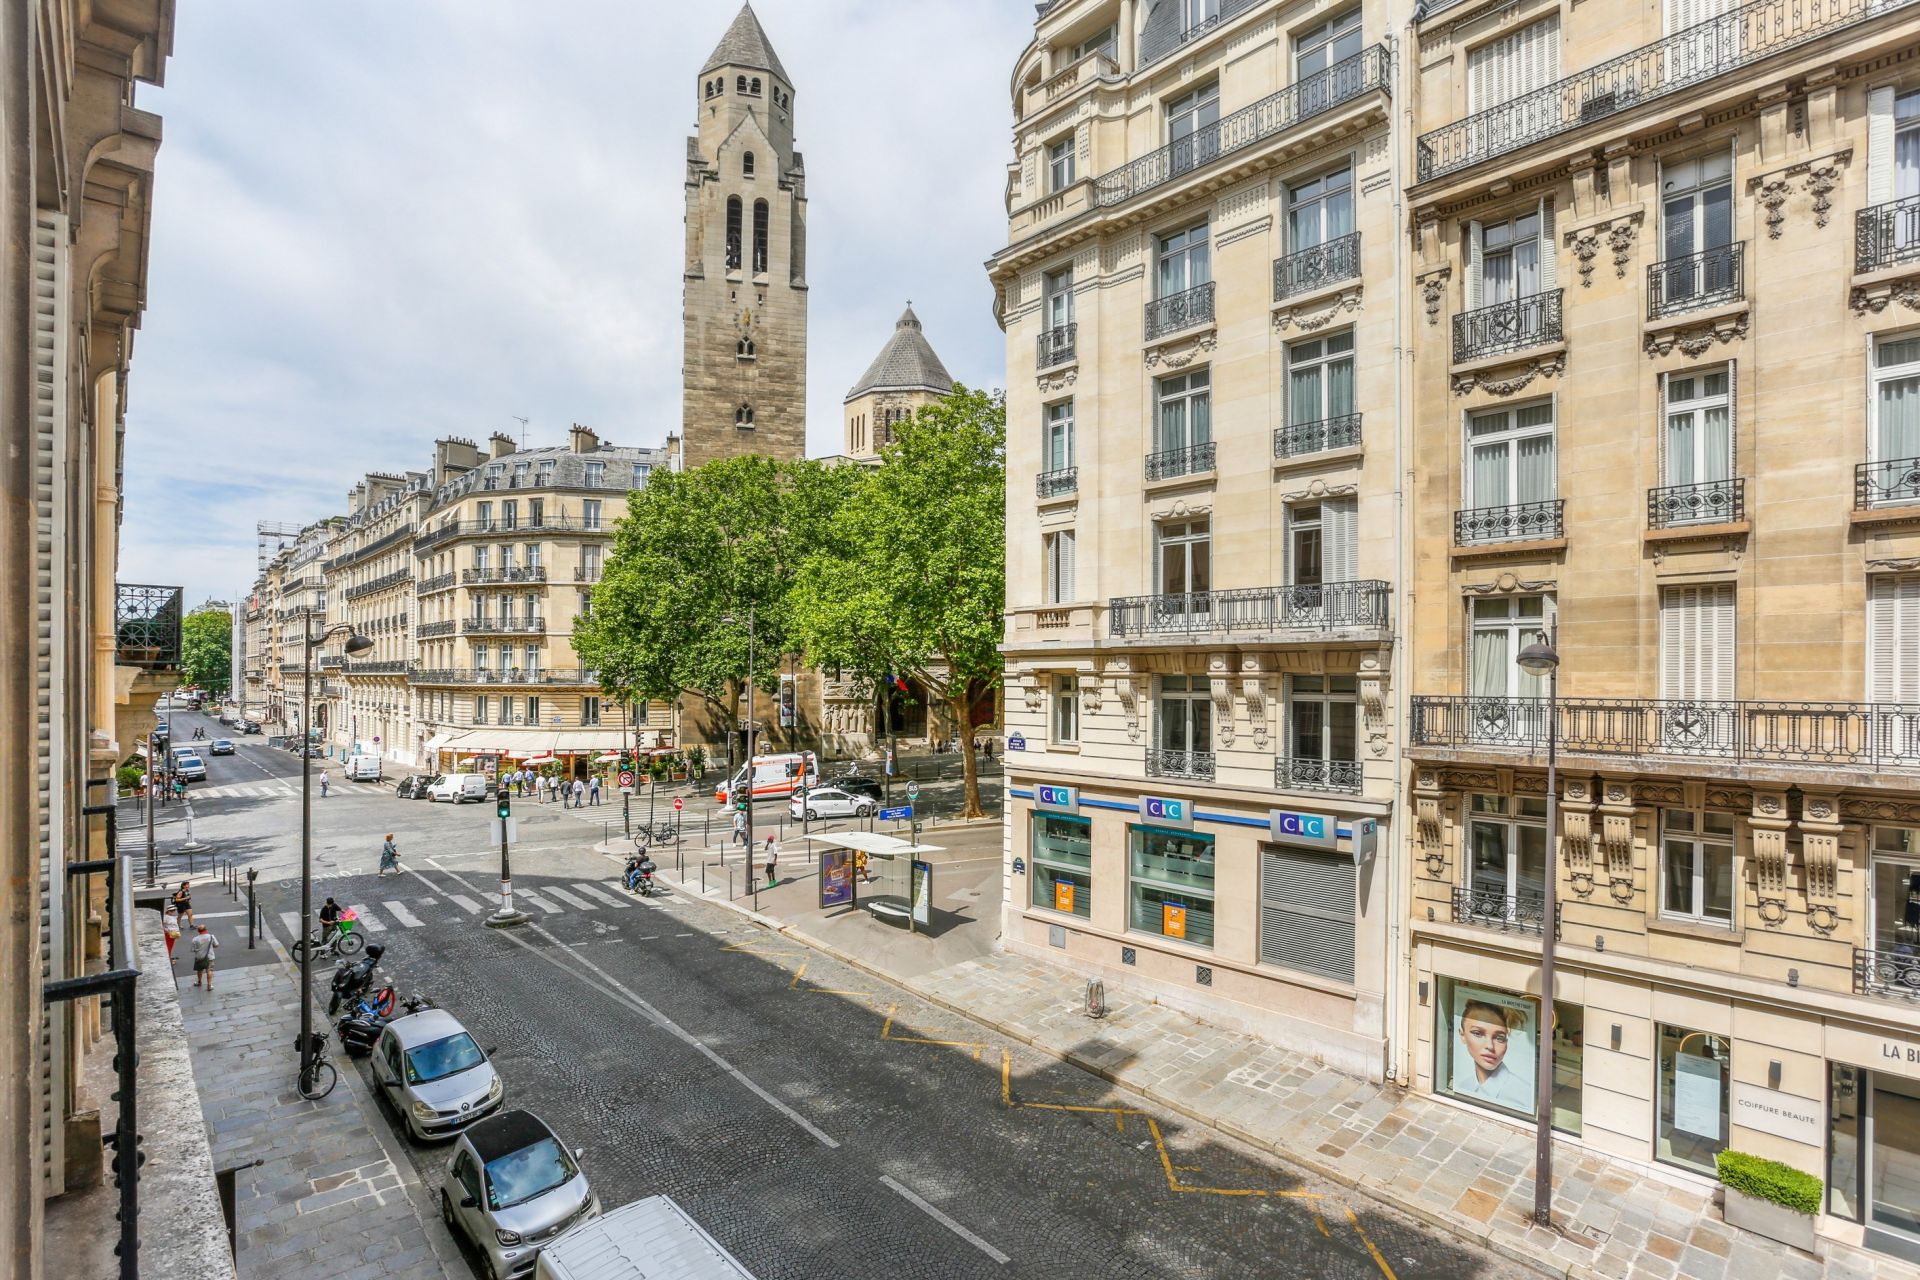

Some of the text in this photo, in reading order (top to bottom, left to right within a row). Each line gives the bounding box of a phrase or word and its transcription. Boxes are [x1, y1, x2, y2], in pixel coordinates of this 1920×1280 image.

[1042, 790, 1067, 803] CIC
[1149, 802, 1179, 817] CIC
[1283, 817, 1320, 835] CIC
[1363, 823, 1375, 834] CIC
[1883, 1043, 1920, 1063] LA BI
[1738, 1099, 1816, 1124] COIFFURE BEAUTE
